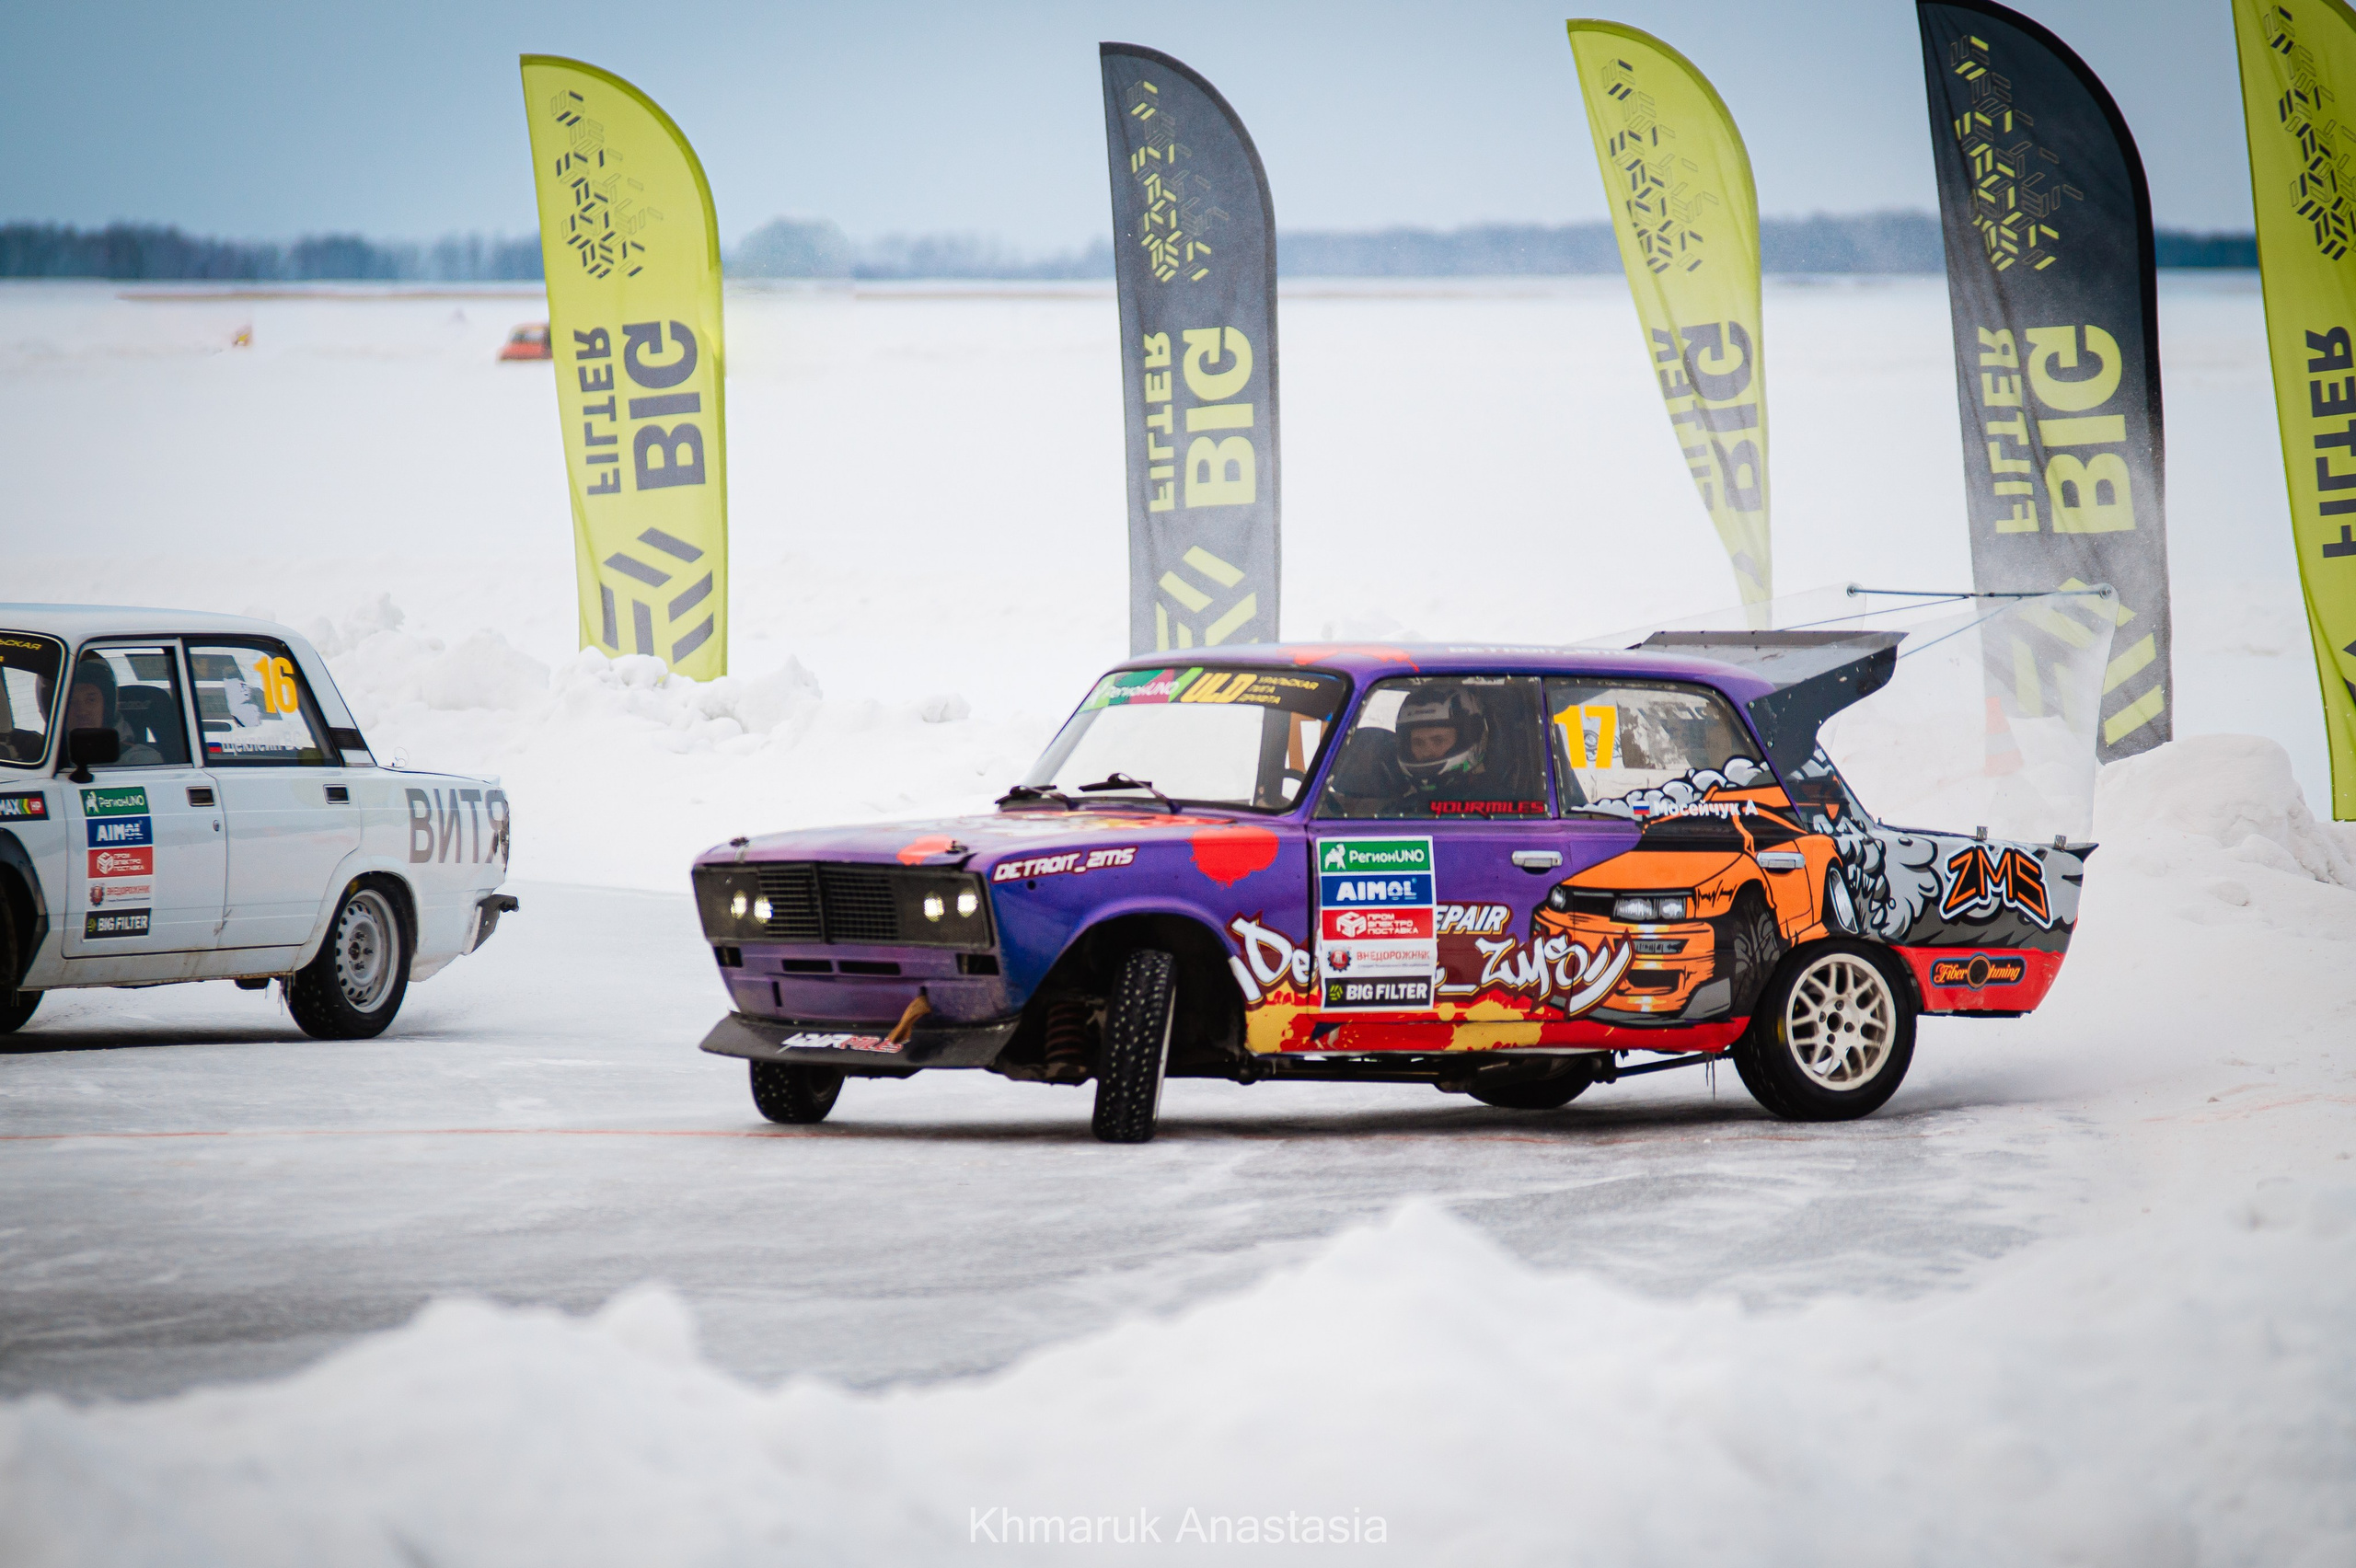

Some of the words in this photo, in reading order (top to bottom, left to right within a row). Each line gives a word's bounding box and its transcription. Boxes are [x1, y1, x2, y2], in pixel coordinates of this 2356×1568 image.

[253, 655, 298, 714] 16
[1180, 672, 1258, 703] ULD
[1553, 704, 1617, 769] 17
[1653, 799, 1741, 820] Мосейчук
[96, 823, 144, 842] AIMOL
[405, 788, 508, 864] ВИТЯ
[1335, 880, 1417, 902] AIMOL
[1944, 847, 2050, 922] ZMS
[97, 917, 115, 931] BIG
[115, 915, 148, 931] FILTER
[1435, 904, 1511, 934] EPAIR
[1934, 963, 1968, 984] Fiber
[1345, 984, 1374, 1001] BIG
[1375, 983, 1428, 1000] FILTER
